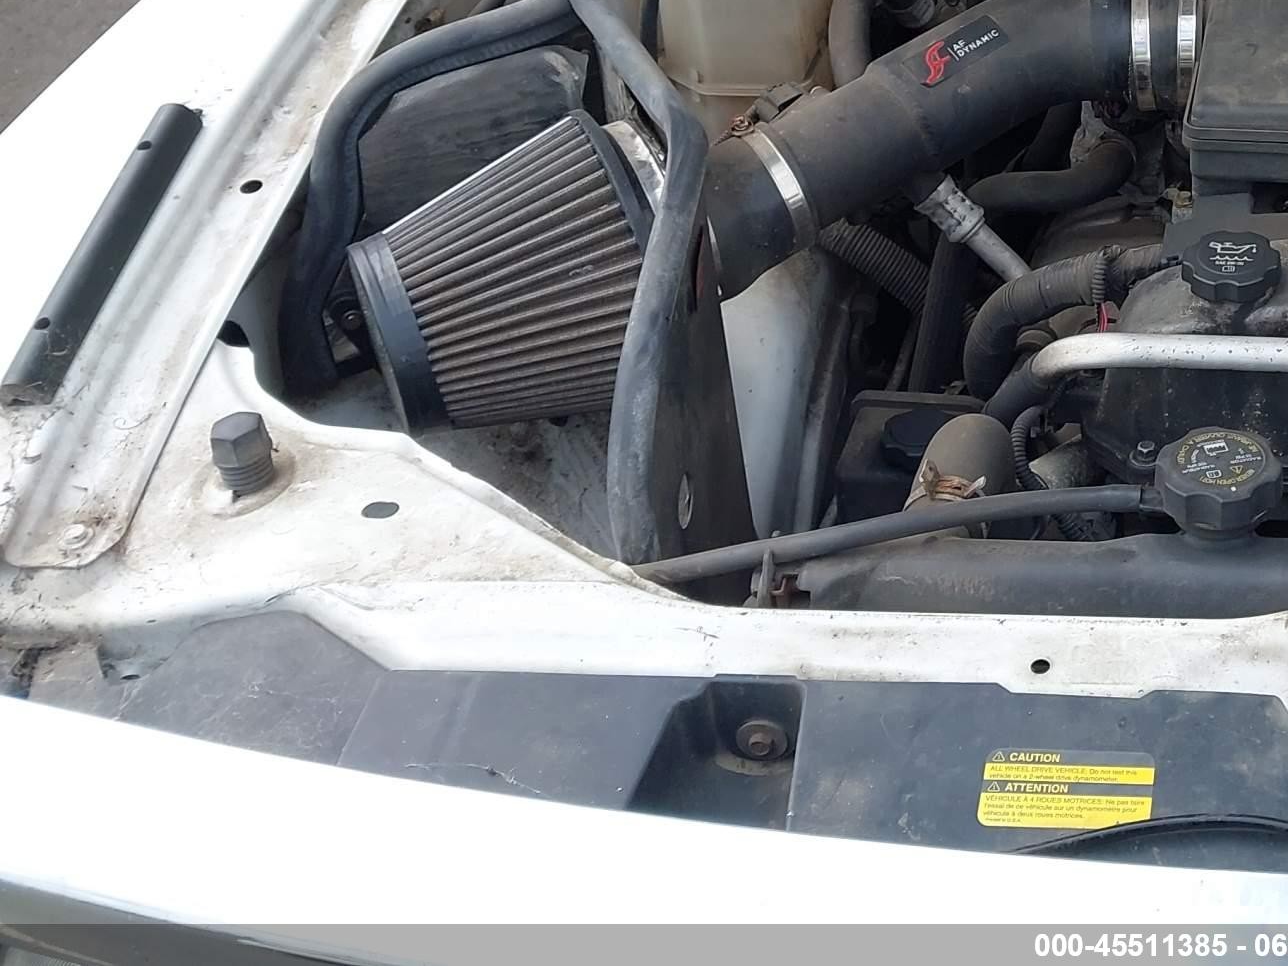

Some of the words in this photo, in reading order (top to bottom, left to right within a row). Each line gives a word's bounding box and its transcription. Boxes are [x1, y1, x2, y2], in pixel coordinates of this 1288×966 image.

[956, 29, 999, 57] DYNAMIC
[1009, 752, 1061, 763] CAUTION
[1004, 783, 1069, 793] ATTENTION
